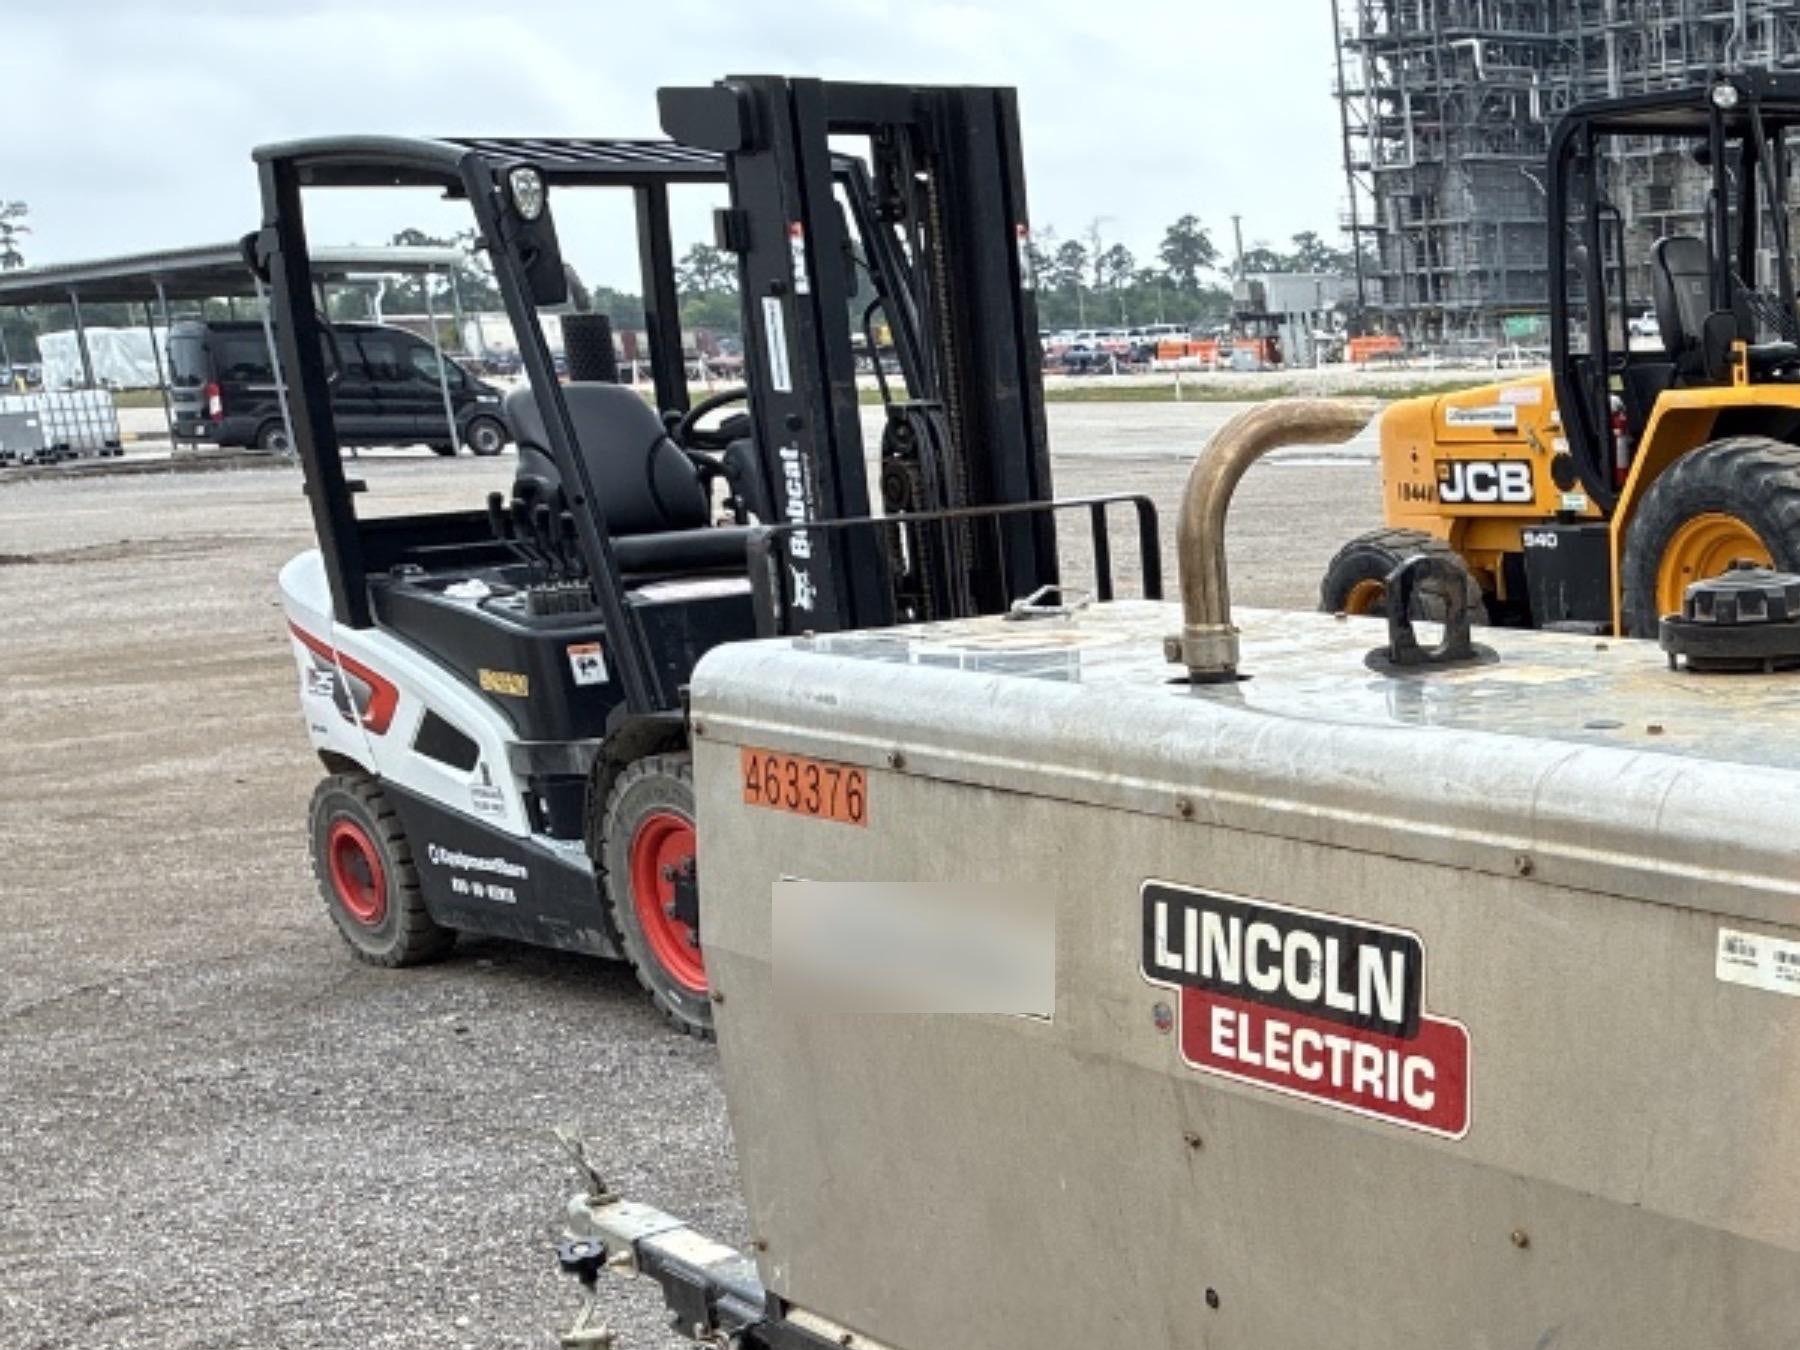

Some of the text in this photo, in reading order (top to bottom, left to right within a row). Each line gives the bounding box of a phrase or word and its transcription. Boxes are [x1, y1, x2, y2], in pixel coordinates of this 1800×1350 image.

[779, 446, 811, 559] Bobcat
[1440, 462, 1532, 502] JCB
[745, 755, 863, 822] 463376
[1155, 901, 1405, 1024] LINCOLN
[1211, 1005, 1436, 1111] ELECTRIC
